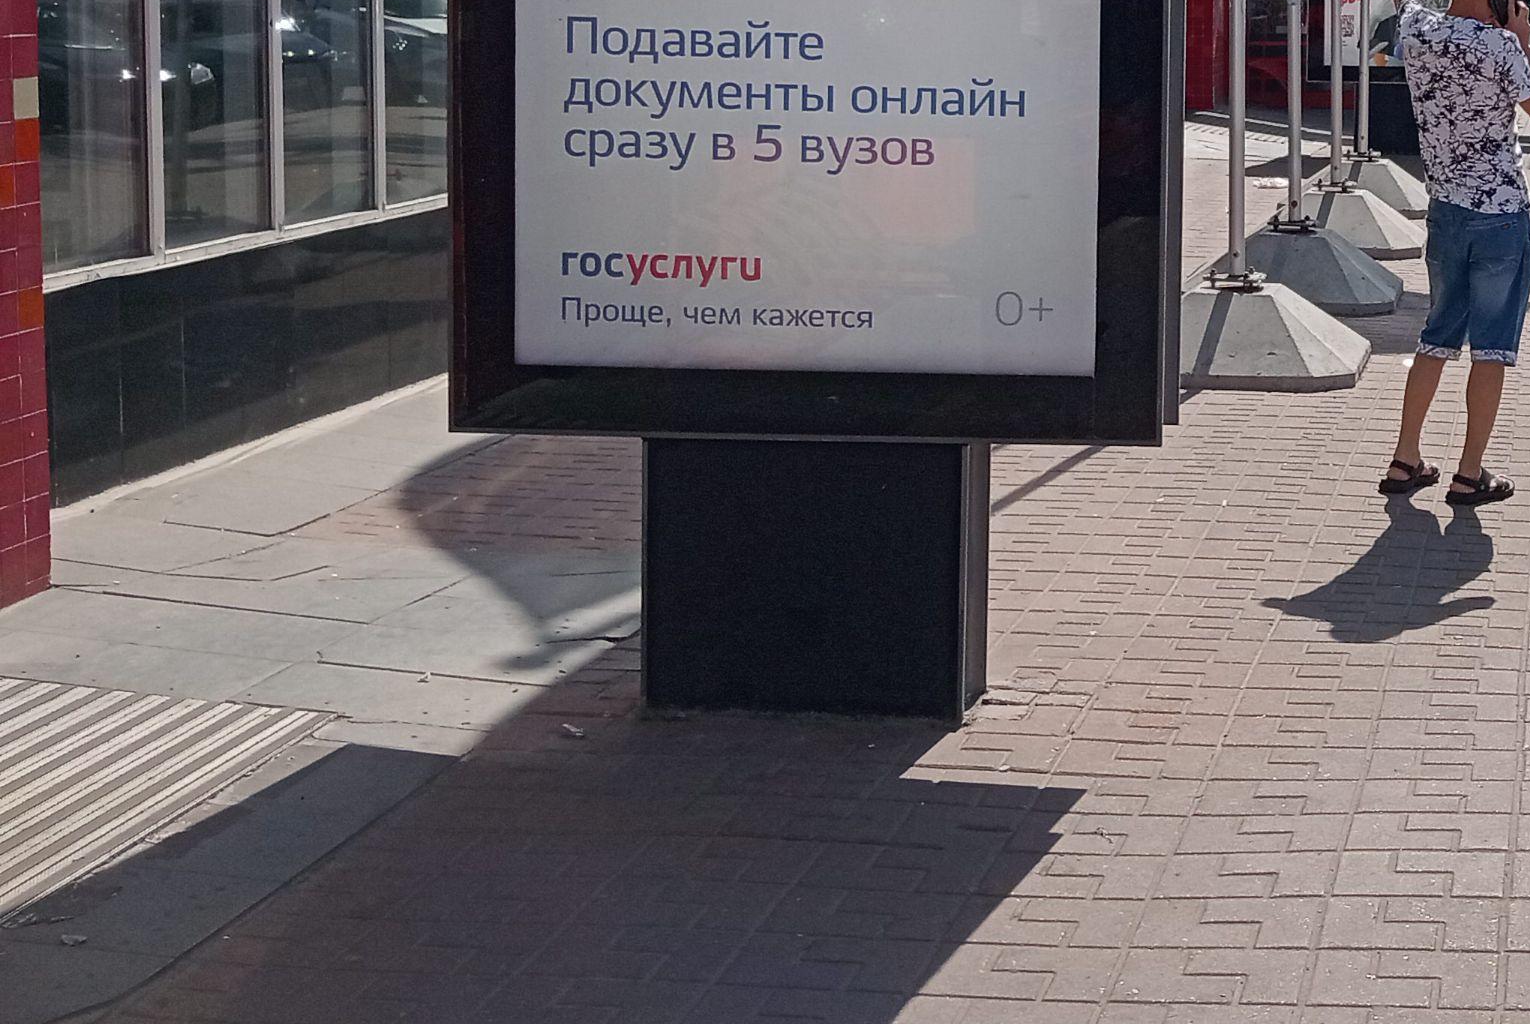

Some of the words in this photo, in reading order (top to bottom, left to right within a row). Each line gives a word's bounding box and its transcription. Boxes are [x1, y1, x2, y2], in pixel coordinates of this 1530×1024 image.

[566, 16, 824, 64] Подавайте
[563, 78, 834, 119] документы
[851, 78, 1026, 118] онлайн
[564, 128, 696, 170] сразу
[712, 132, 736, 160] в
[753, 124, 783, 162] 5
[801, 135, 935, 175] вузов
[561, 297, 672, 326] Проще,
[683, 305, 741, 325] чем
[752, 308, 873, 329] кажется
[995, 291, 1054, 326] 0+
